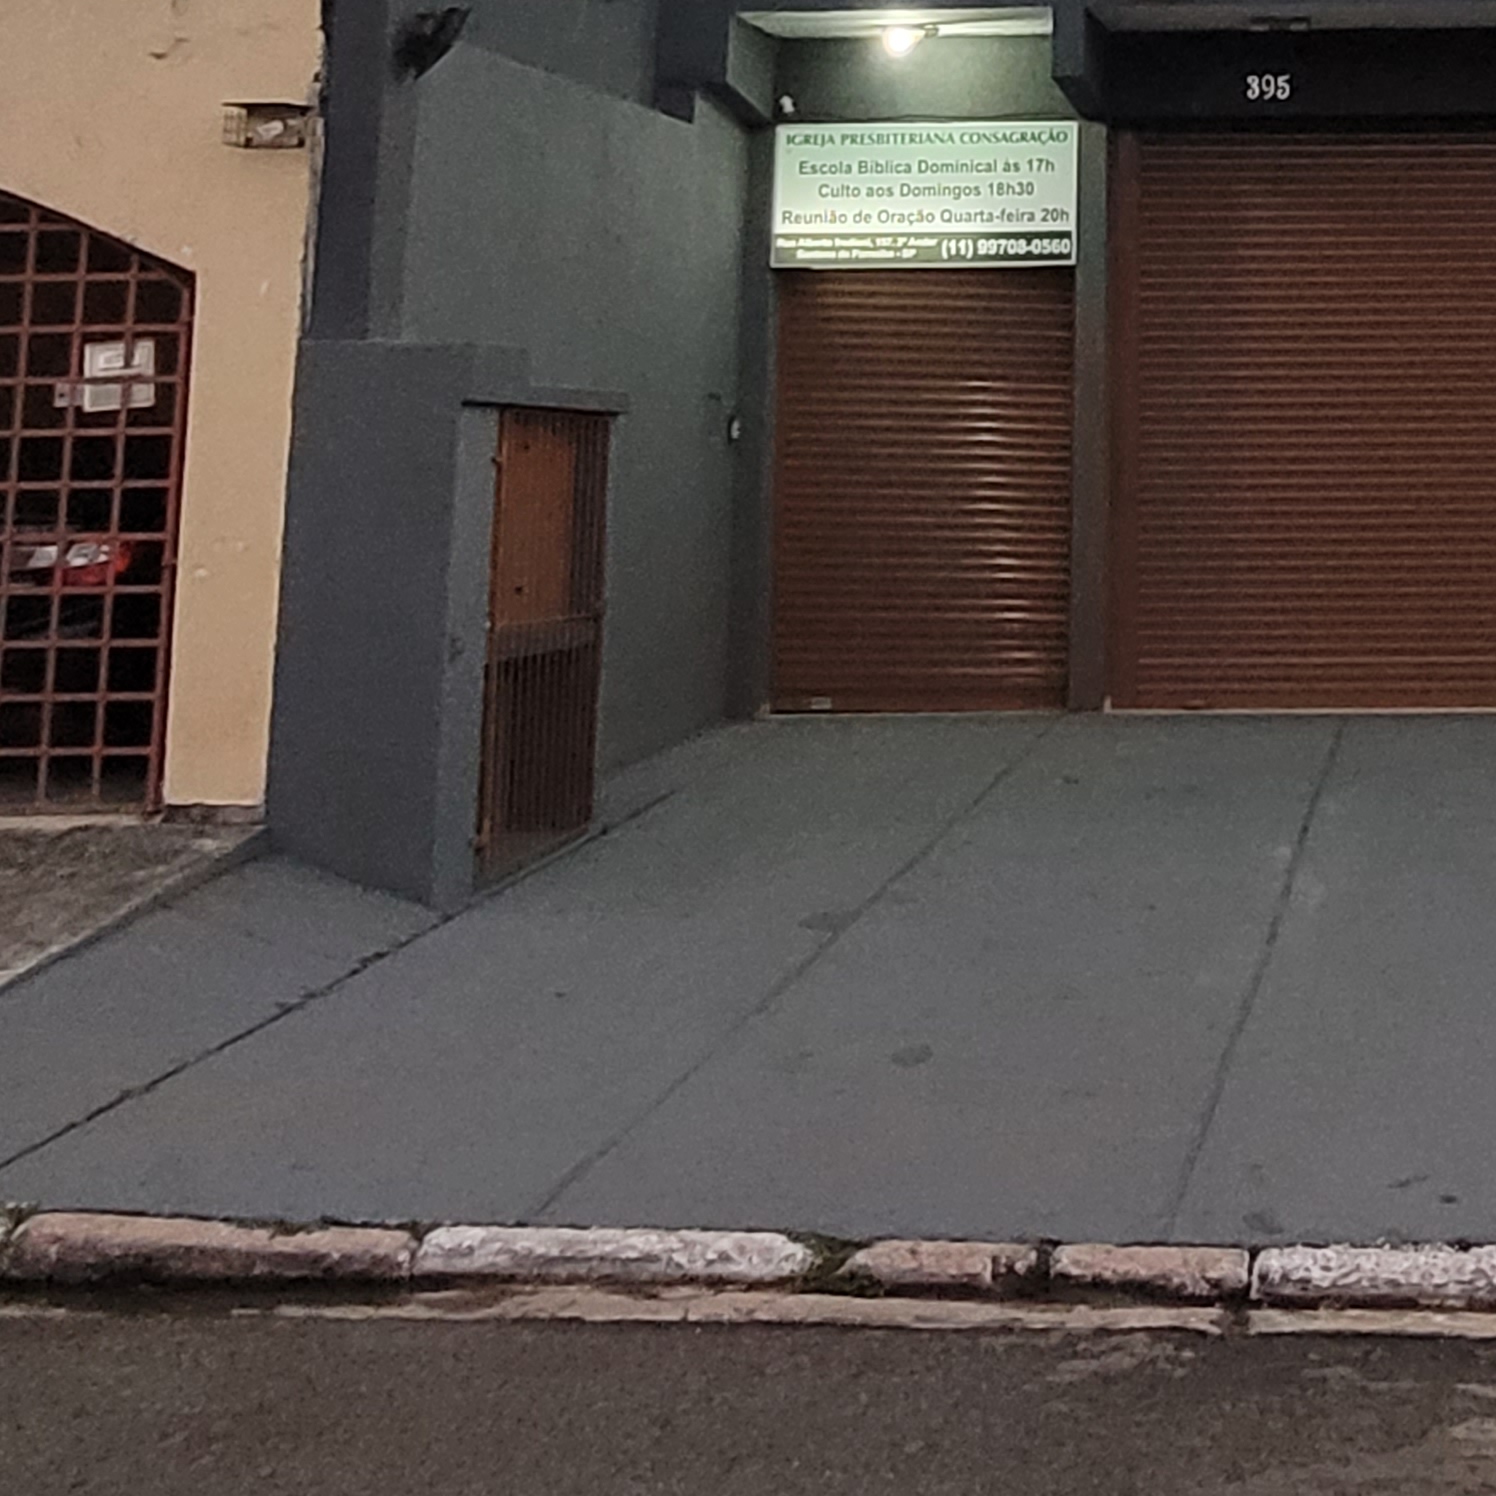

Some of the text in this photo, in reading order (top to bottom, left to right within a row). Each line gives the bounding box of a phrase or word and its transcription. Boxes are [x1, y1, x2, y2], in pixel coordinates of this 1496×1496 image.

[1246, 73, 1291, 101] 395
[785, 127, 1069, 148] IGREJA PRESBITERIANA CONSAGRAÇÃO
[798, 160, 853, 175] Escola
[917, 158, 998, 174] Dominical
[1027, 158, 1056, 173] 17h
[818, 181, 1035, 201] Culto aos Domingos 18h30
[781, 207, 1070, 226] Reunião de Oração Quarta-feira 20h
[941, 237, 974, 260] (11)
